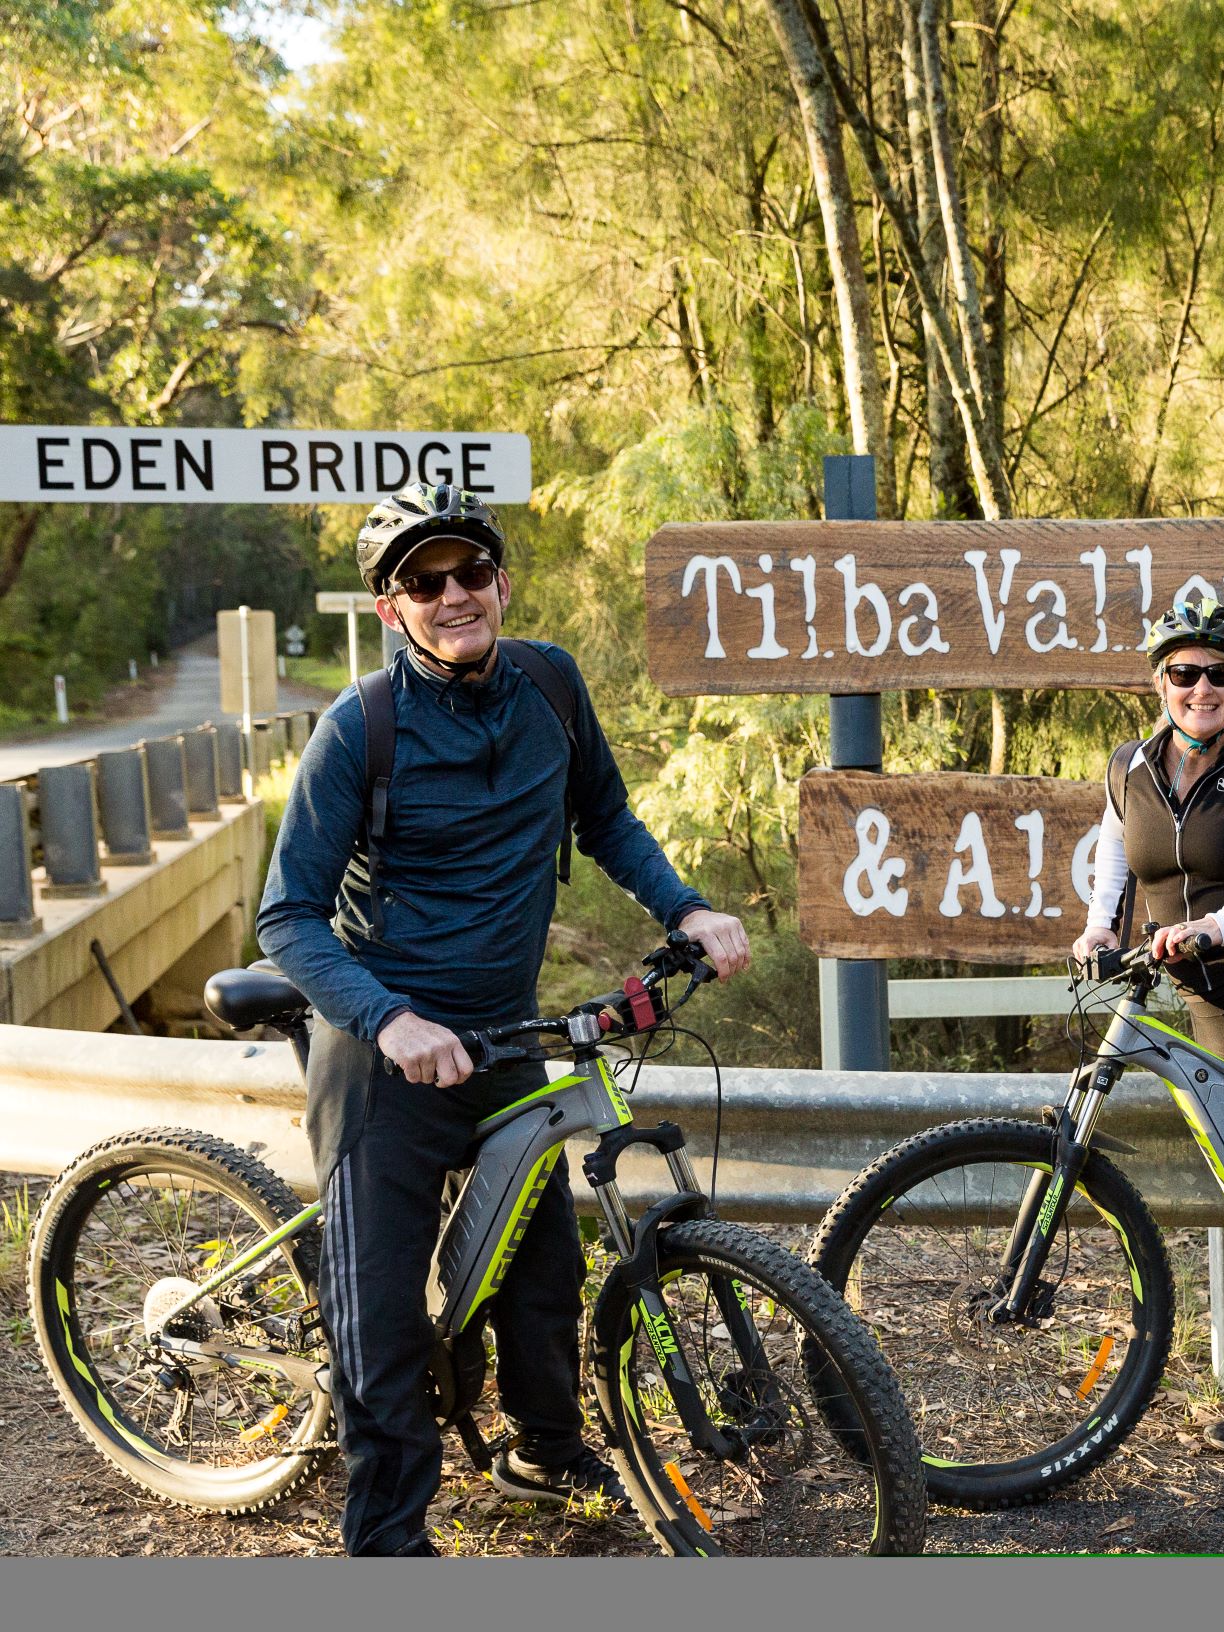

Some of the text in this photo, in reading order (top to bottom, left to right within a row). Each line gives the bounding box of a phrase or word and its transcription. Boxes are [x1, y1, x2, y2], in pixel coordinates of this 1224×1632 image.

[37, 437, 496, 493] EDEN BRIDGE
[682, 553, 951, 660] Tilba
[843, 808, 909, 917] &
[650, 1311, 679, 1354] XCM
[1040, 1413, 1119, 1478] MAXXIS
